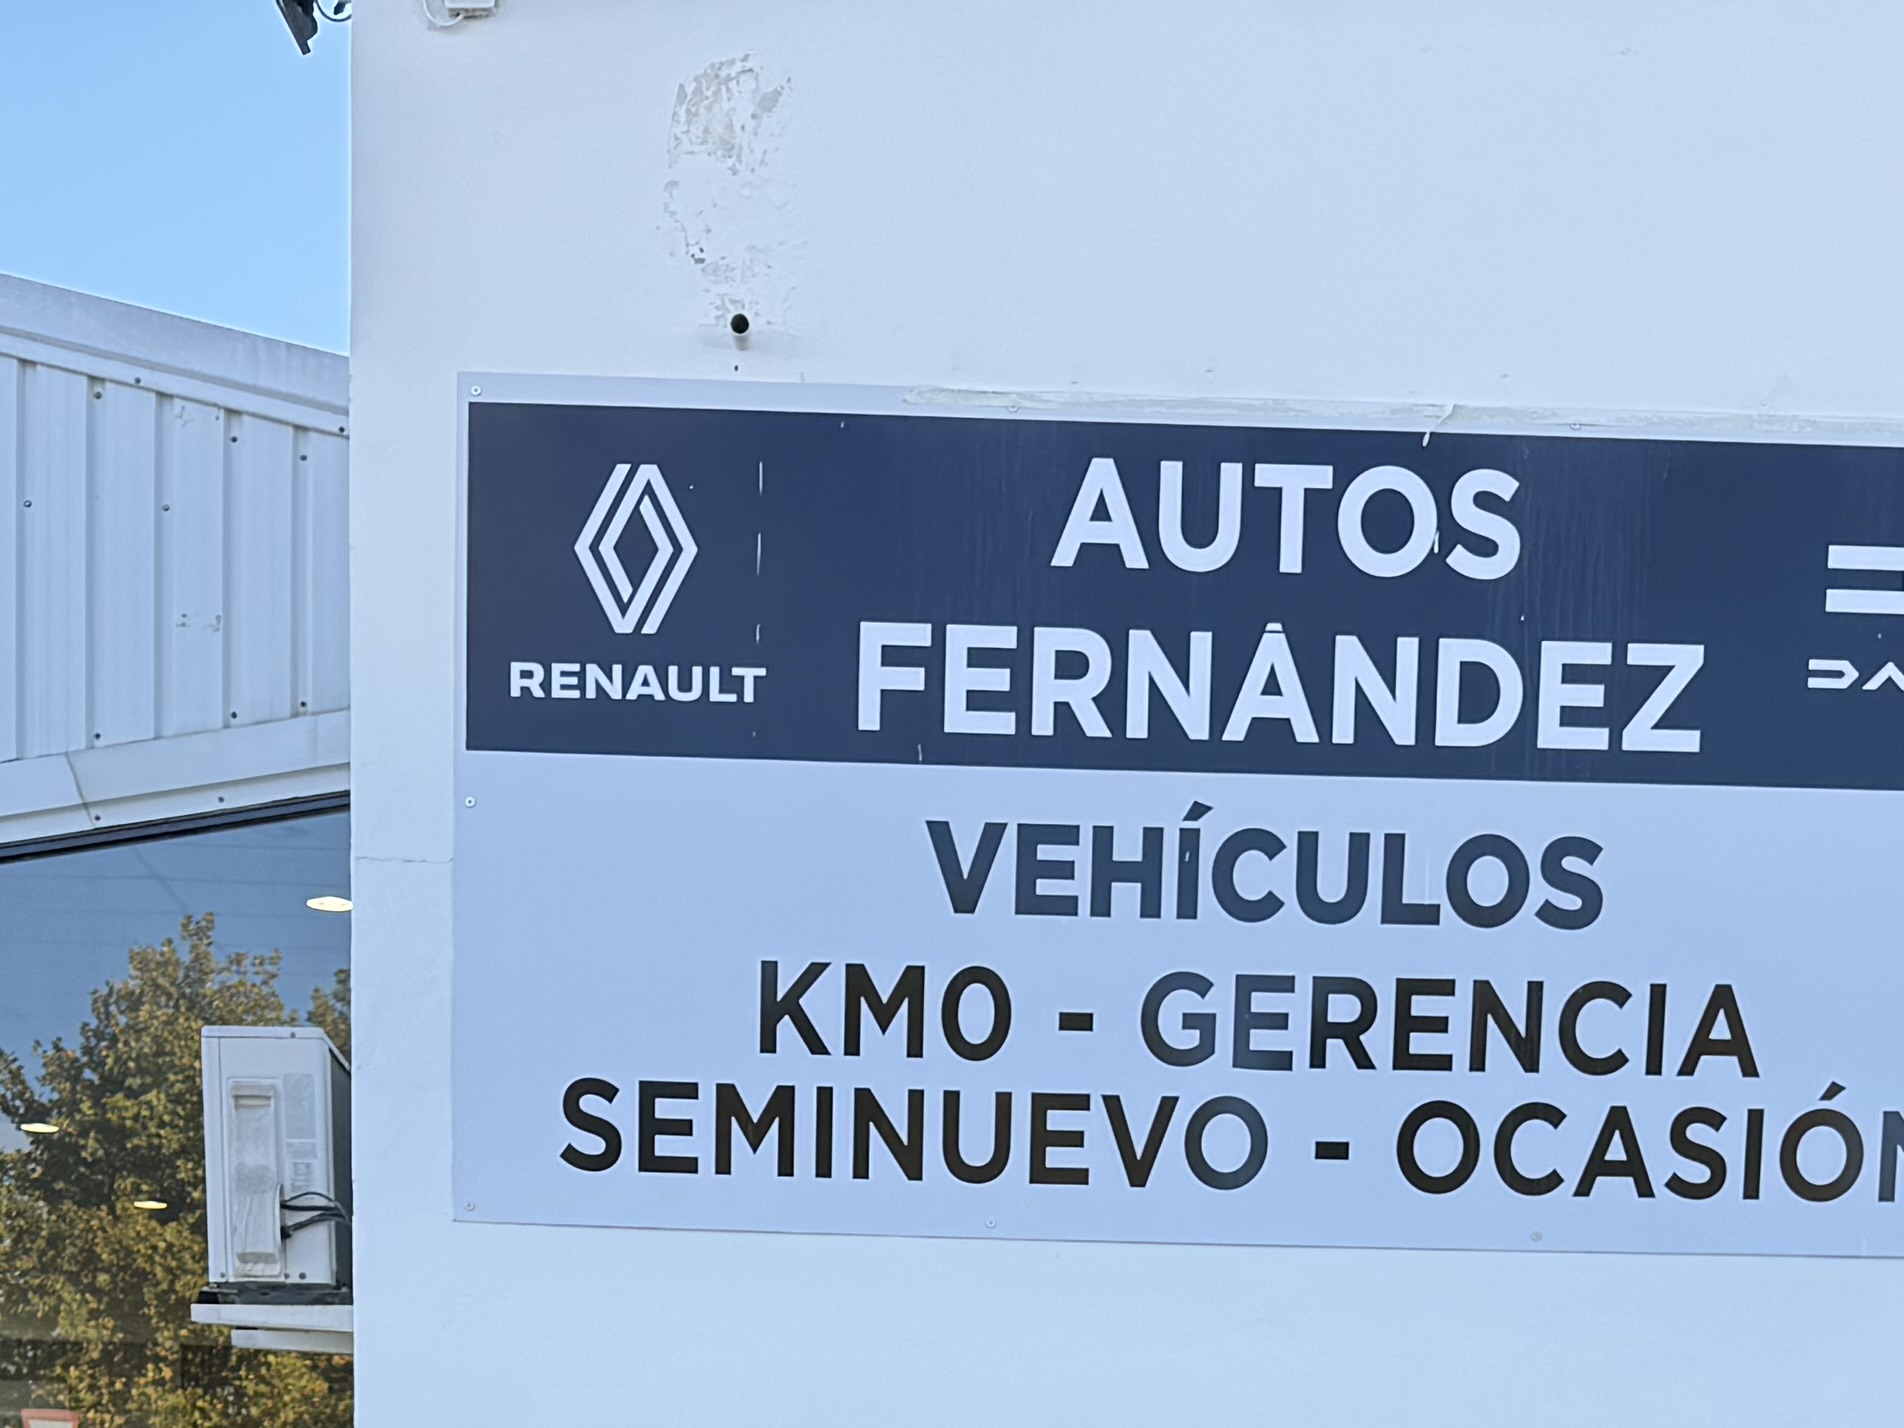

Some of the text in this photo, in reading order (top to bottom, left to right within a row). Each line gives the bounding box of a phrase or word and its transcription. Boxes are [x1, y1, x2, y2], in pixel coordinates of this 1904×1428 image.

[1051, 458, 1521, 580] AUTOS
[510, 661, 767, 703] RENAULT
[857, 621, 1705, 753] FERNÁNDEZ
[924, 800, 1604, 931] VEHÍCULOS
[1140, 971, 1760, 1079] GERENCIA
[559, 1077, 1269, 1191] SEMINUEVO
